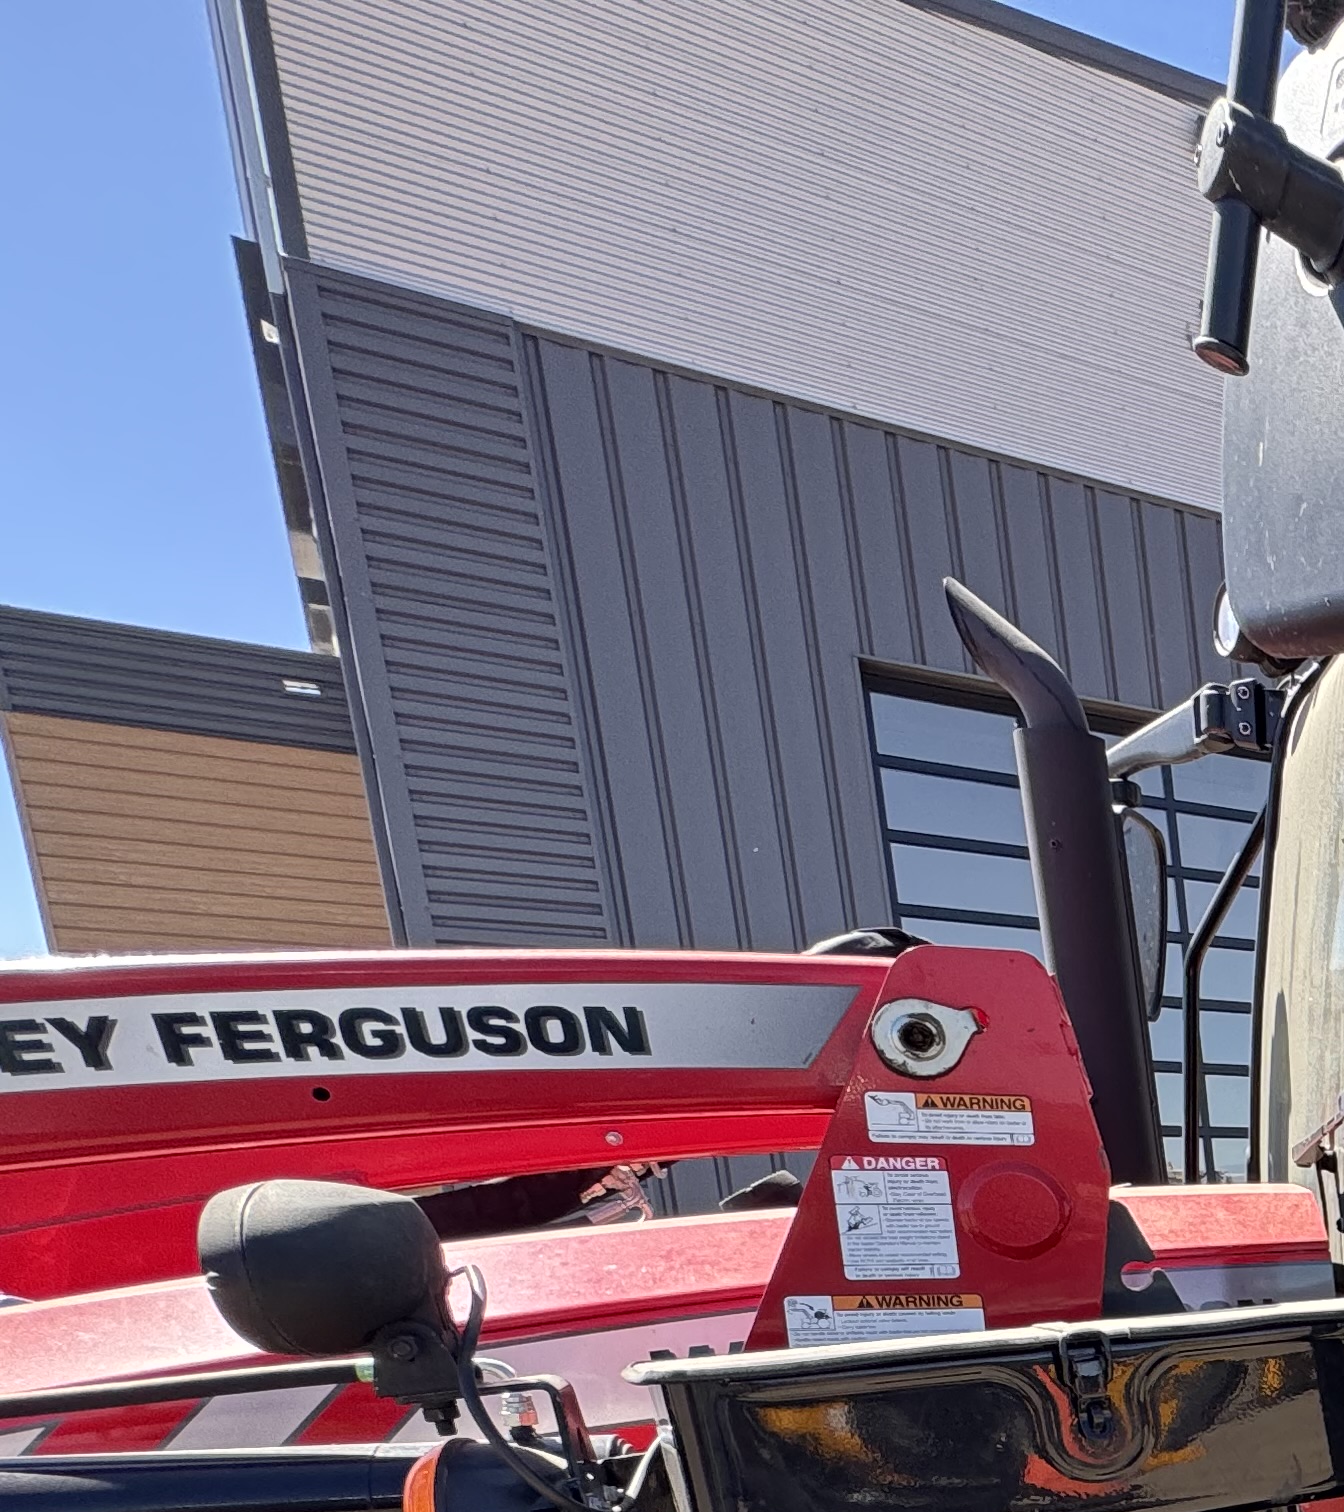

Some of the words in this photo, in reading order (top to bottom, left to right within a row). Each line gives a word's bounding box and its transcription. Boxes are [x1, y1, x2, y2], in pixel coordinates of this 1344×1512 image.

[151, 1005, 652, 1067] FERGUSON
[941, 1096, 1026, 1110] WARNING
[862, 1156, 940, 1170] DANGER
[875, 1295, 964, 1308] WARNING
